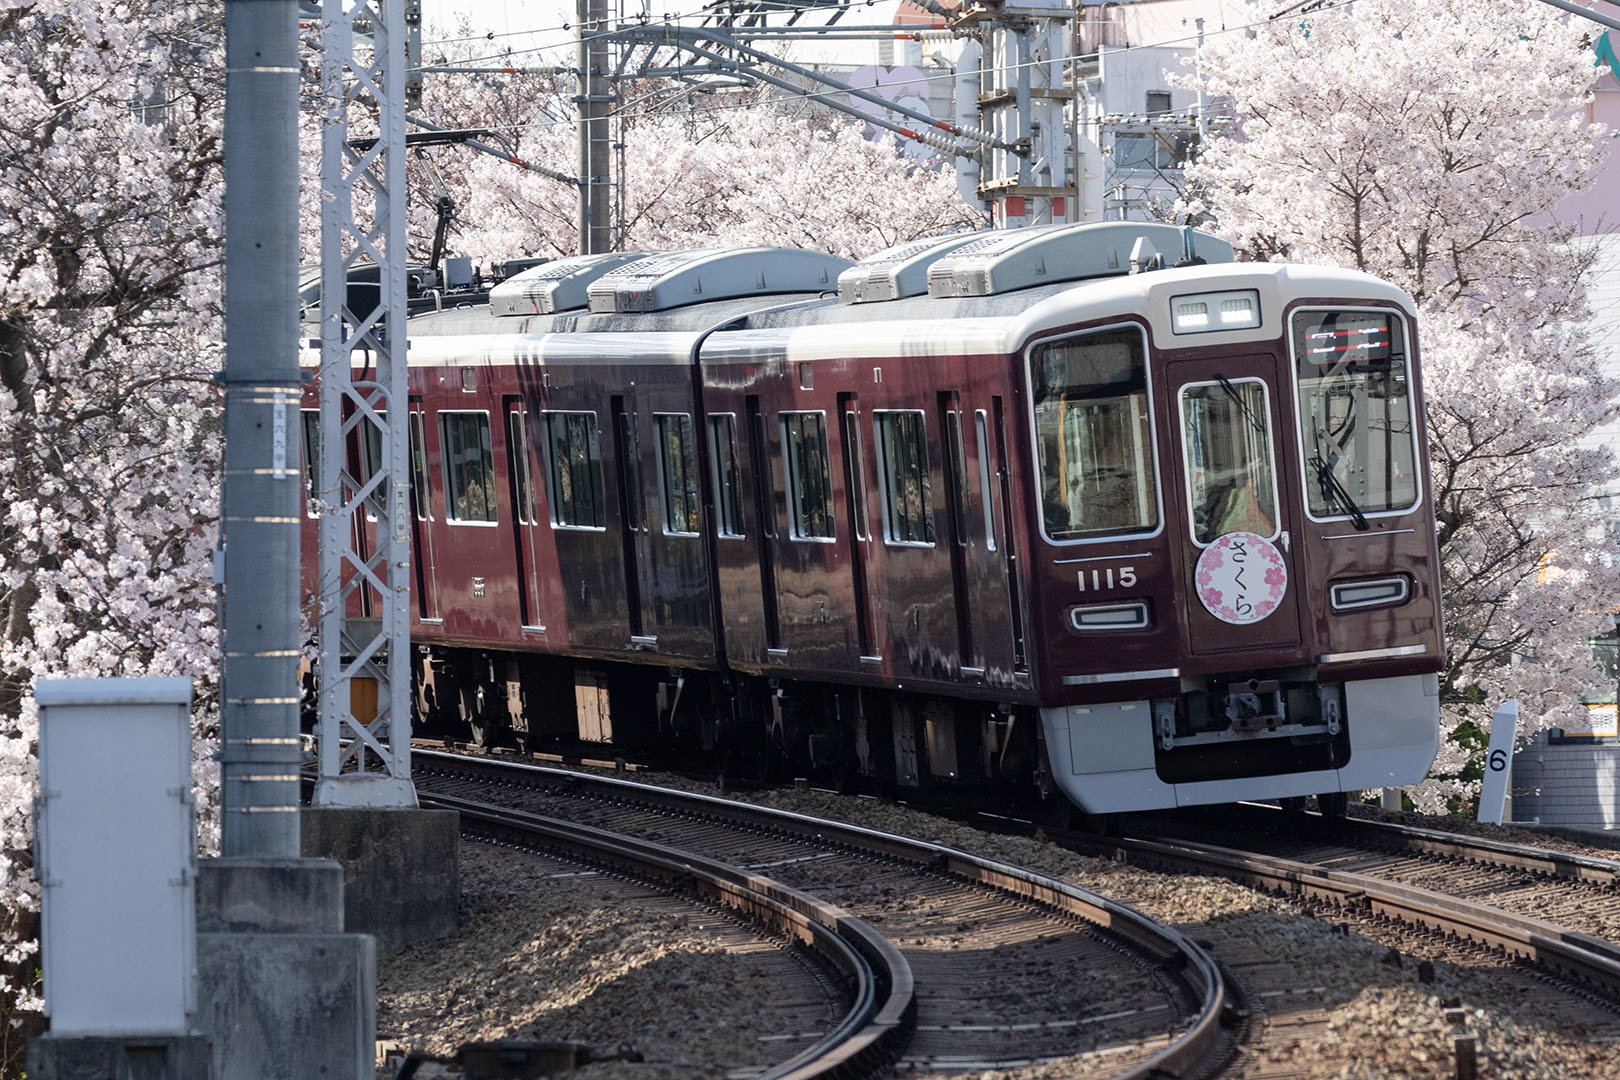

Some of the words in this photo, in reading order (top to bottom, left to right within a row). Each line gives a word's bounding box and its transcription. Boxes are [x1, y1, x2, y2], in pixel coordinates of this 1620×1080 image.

[1077, 566, 1137, 592] 1115
[1229, 541, 1252, 615] さくら
[1490, 749, 1507, 772] 6
